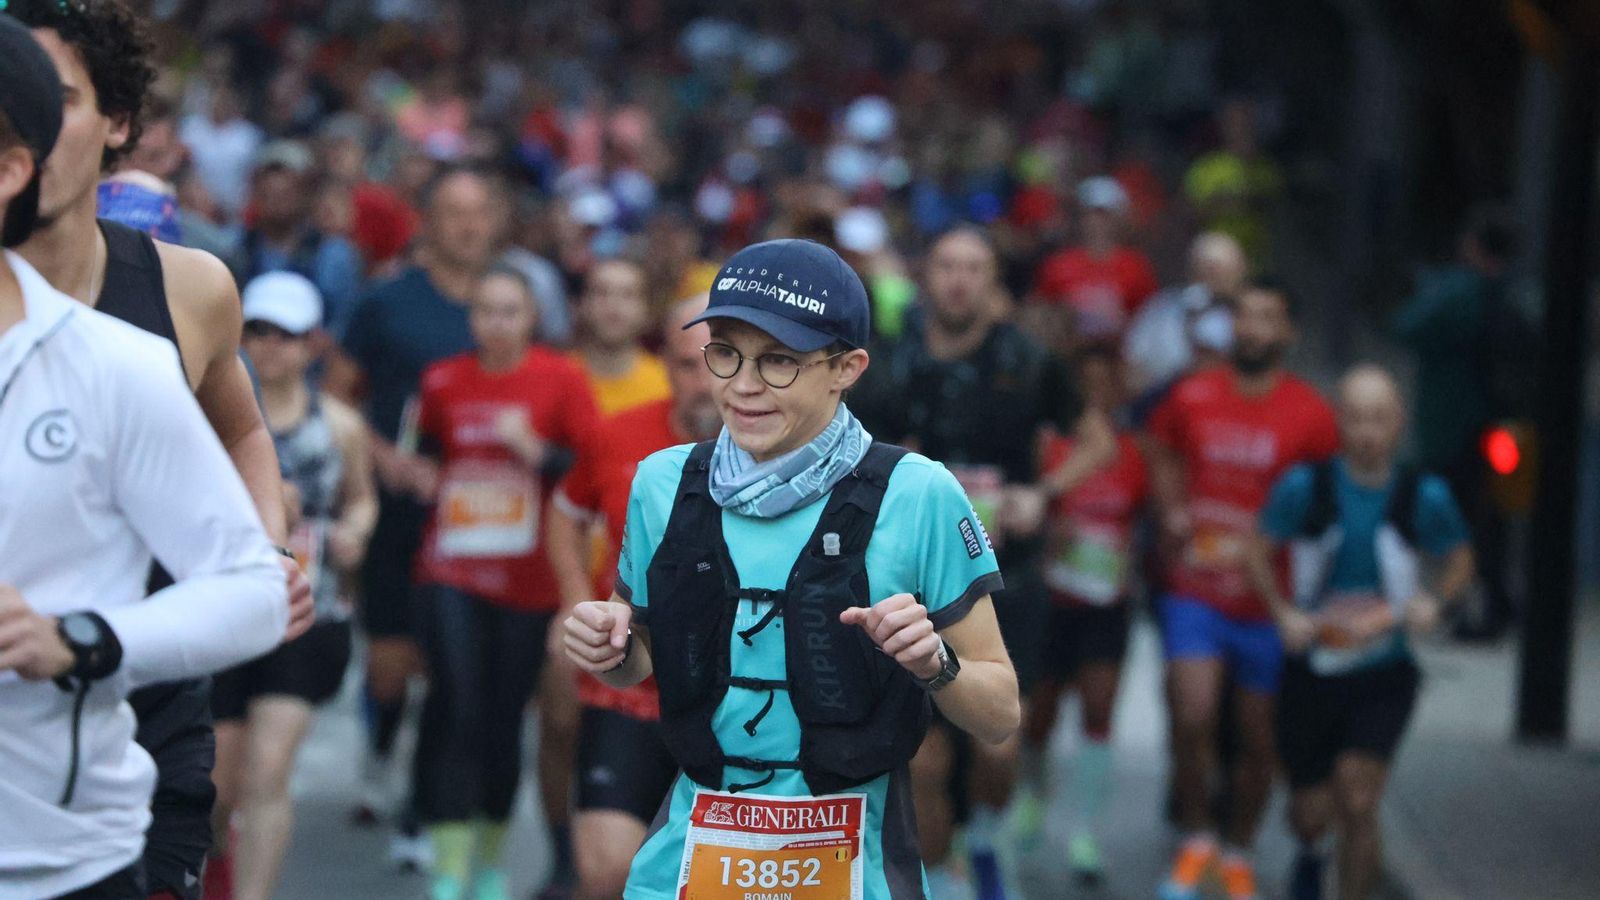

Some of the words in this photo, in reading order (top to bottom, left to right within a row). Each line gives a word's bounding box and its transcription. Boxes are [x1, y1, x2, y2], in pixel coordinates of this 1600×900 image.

[726, 266, 828, 297] SCUDERIA
[732, 279, 826, 315] ALPHATAURI
[960, 520, 981, 556] RESPECT
[801, 583, 847, 709] KIPRUN
[737, 804, 849, 829] GENERALI
[720, 856, 821, 888] 13852
